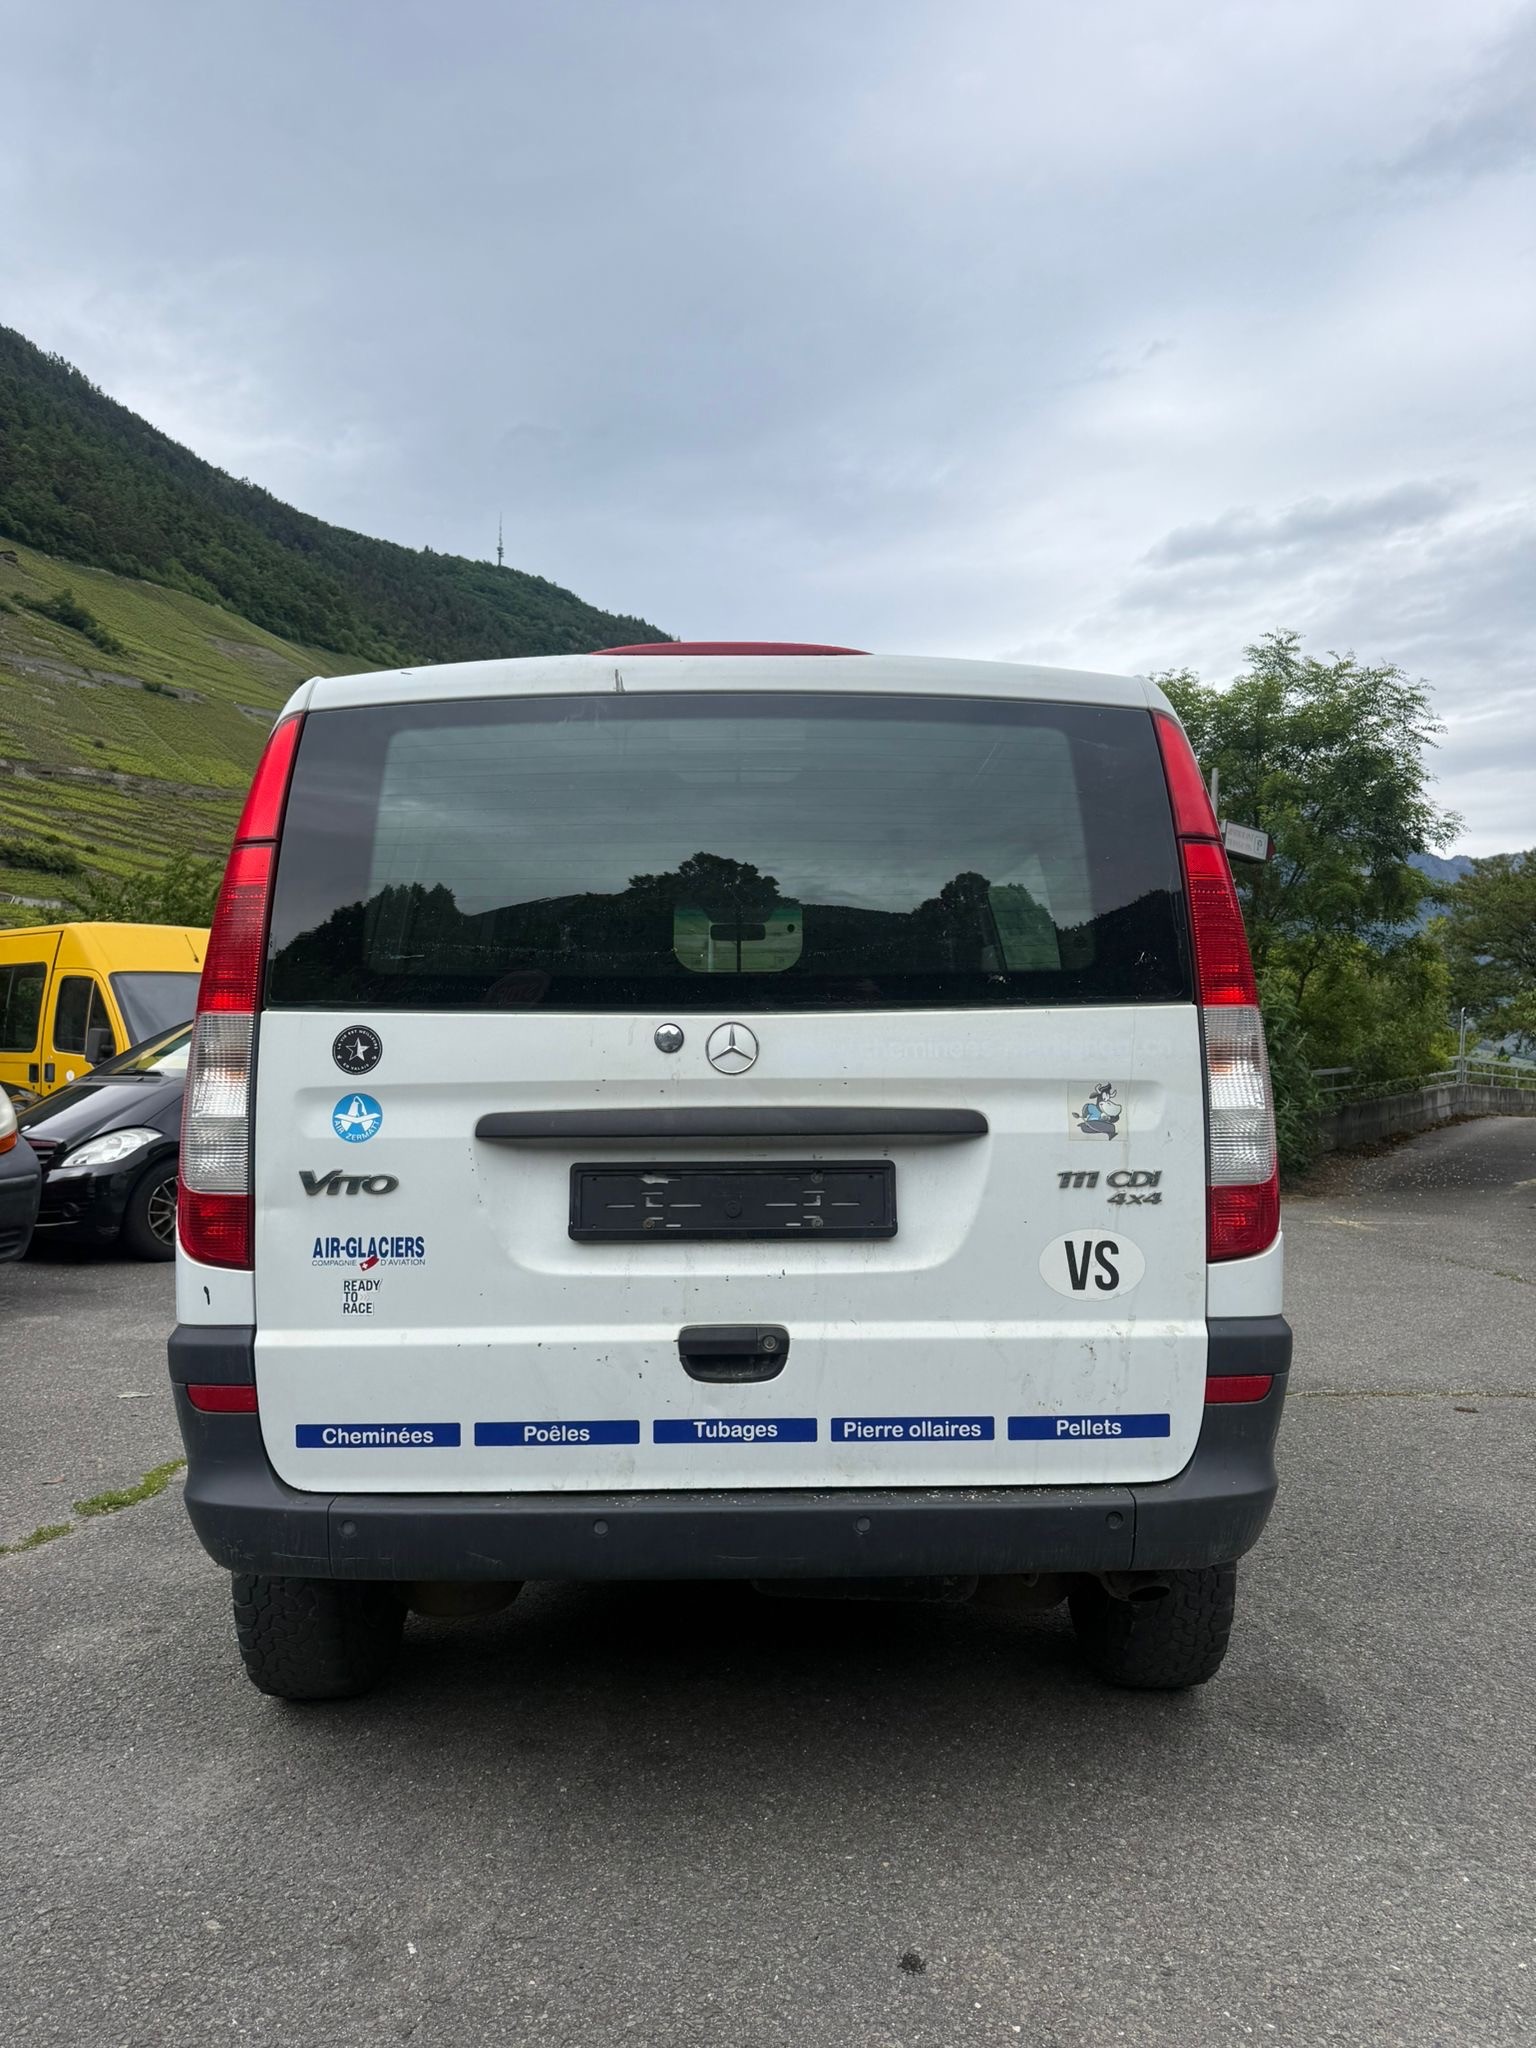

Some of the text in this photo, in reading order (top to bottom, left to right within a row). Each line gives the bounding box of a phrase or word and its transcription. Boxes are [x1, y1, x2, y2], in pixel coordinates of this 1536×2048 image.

[334, 1120, 380, 1141] AIR ZERMATT
[1057, 1170, 1162, 1189] 111 CDI
[1107, 1192, 1162, 1205] 4x4
[312, 1236, 425, 1258] AIR-GLACIERS
[311, 1258, 426, 1267] COMPAGNIE D'AVIATION
[1064, 1240, 1120, 1291] VS
[343, 1280, 380, 1292] READY
[343, 1291, 358, 1302] TO
[343, 1302, 373, 1314] RACE
[321, 1427, 434, 1445] Cheminées
[523, 1425, 590, 1442] Poêles
[693, 1421, 778, 1441] Tubages
[843, 1420, 982, 1438] Pierre ollaires
[1056, 1419, 1122, 1436] Pellets
